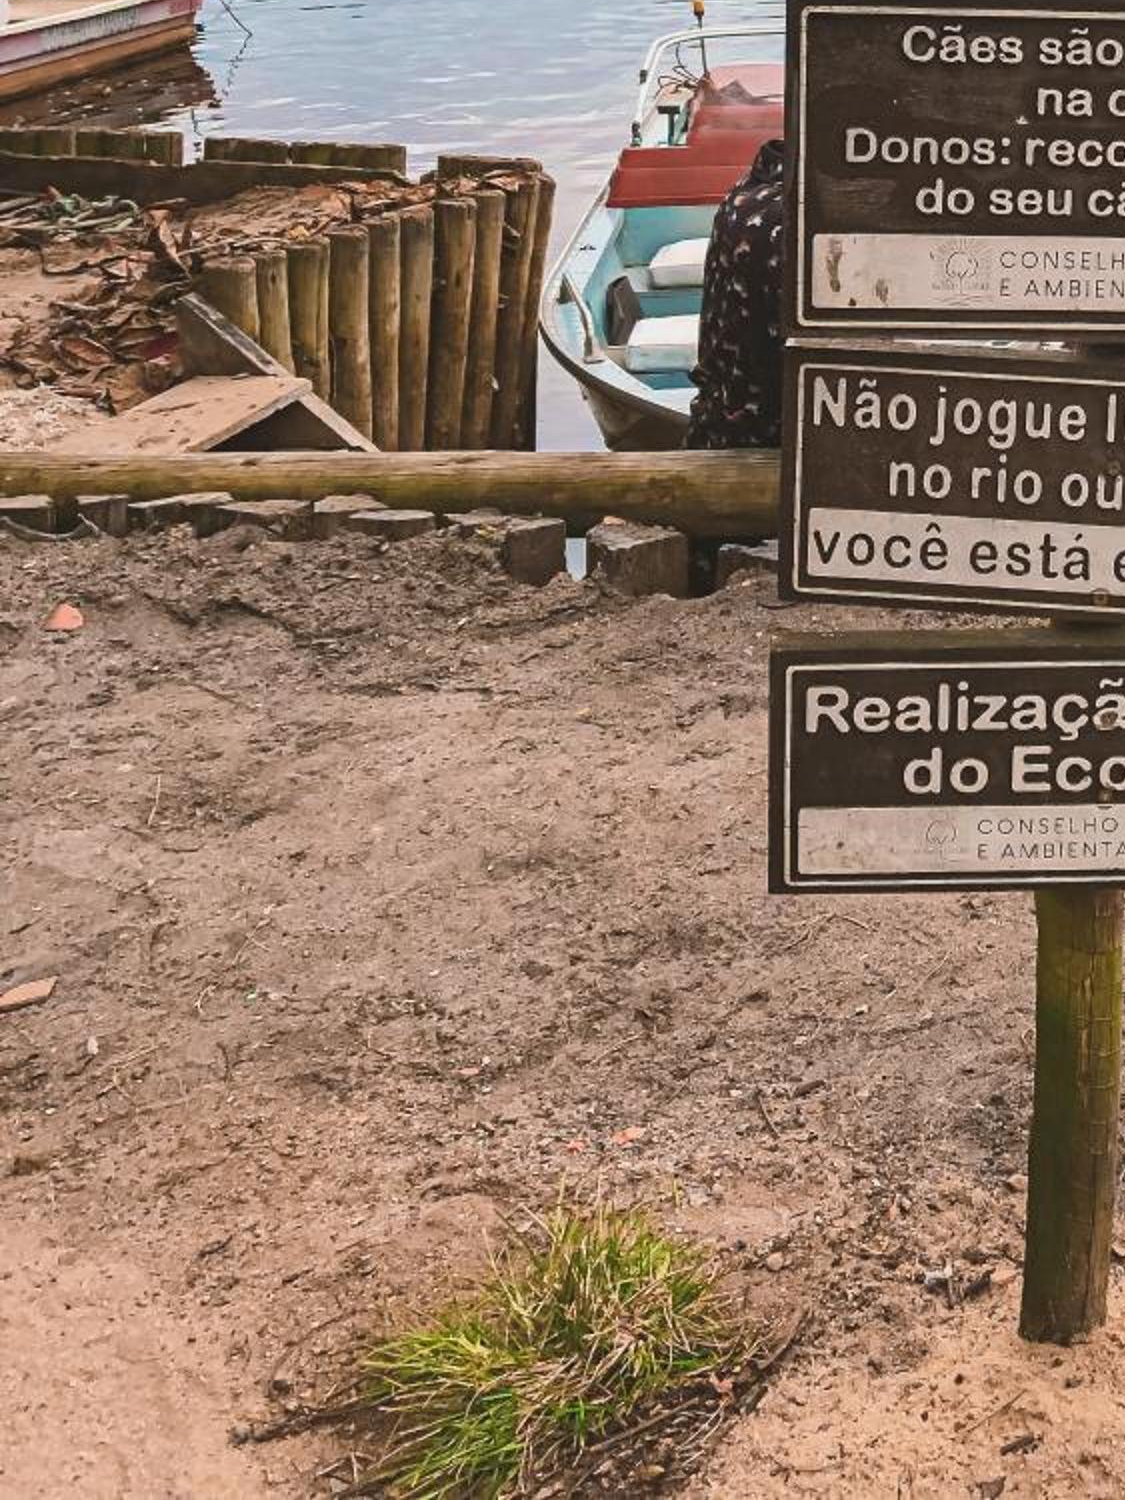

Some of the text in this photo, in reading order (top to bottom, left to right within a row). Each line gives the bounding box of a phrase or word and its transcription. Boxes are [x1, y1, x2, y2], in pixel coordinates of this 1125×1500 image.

[903, 25, 1023, 63] Cães
[1040, 28, 1123, 65] são
[1038, 88, 1093, 116] na
[846, 128, 1010, 164] Donos:
[916, 178, 974, 214] do
[990, 189, 1072, 215] seu
[1000, 278, 1011, 297] E
[814, 377, 916, 430] Não
[930, 386, 1086, 449] jogue
[890, 462, 952, 498] no
[972, 454, 1042, 504] rio
[1062, 474, 1123, 510] ou
[813, 522, 948, 570] você
[970, 534, 1090, 580] está
[904, 747, 988, 793] do
[978, 818, 1118, 834] CONSELHO
[978, 844, 986, 858] E
